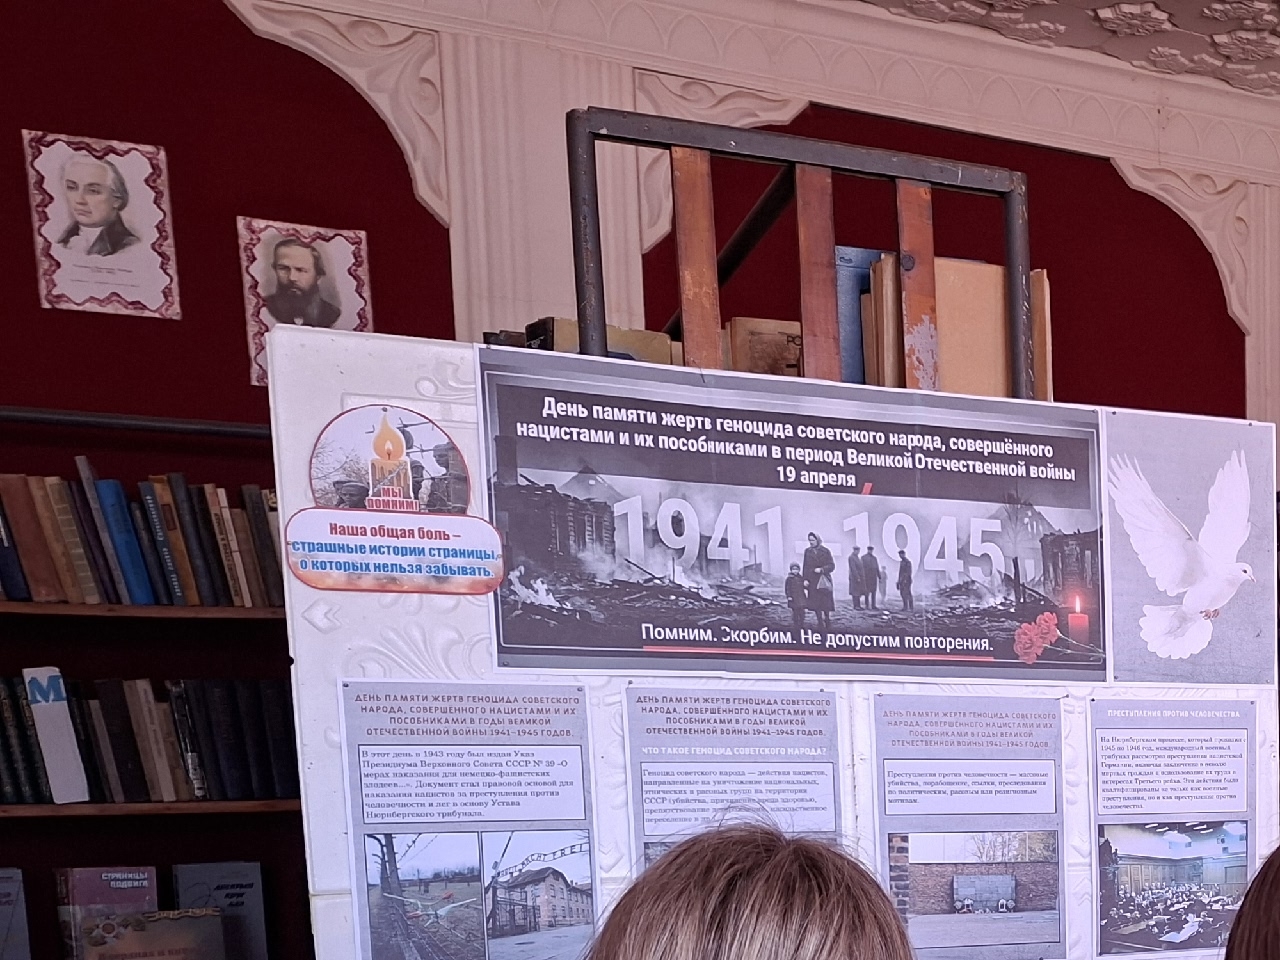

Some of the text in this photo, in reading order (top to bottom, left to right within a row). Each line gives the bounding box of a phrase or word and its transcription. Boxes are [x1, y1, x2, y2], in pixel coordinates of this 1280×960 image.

[542, 396, 1054, 460] День памяти жертв геноцида советского народа, совершённого
[516, 421, 1076, 481] нацистами и их пособниками в период Великой Отечественной войны
[776, 465, 856, 488] 19 апреля
[382, 487, 402, 497] МЫ
[329, 522, 367, 536] Наша
[370, 525, 416, 540] общая
[418, 527, 450, 540] боль
[291, 541, 497, 561] страшные истории страницы,
[300, 559, 494, 577] о которых нельзя забывать.
[641, 623, 718, 643] Помним.
[800, 629, 823, 646] Не
[825, 632, 900, 651] допустим
[905, 635, 994, 653] повторения.
[28, 675, 67, 704] М
[354, 694, 579, 704] ДЕНЬ ПАМЯТИ ЖЕРТВ ГЕНОЦИДА СОВЕТСКОГО
[636, 696, 830, 707] ДЕНЬ ПАМЯТИ ЖЕРТВ ГЕНОЦИДА СОВЕТСКОГО
[360, 705, 406, 714] НАРОДА,
[489, 706, 550, 715] НАЦИСТАМИ
[554, 707, 559, 715] И
[563, 707, 575, 715] ИХ
[389, 717, 550, 725] ПОСОБНИКАМИ В ГОДЫ ВЕЛИКОЙ
[665, 717, 732, 725] ПОСОБНИКАМИ
[768, 718, 805, 726] ВЕЛИКОЙ
[366, 728, 449, 736] ОТЕЧЕСТВЕННОЙ
[452, 728, 486, 736] ВОЙНЫ
[642, 747, 826, 756] ЧТО ТАКОЕ ГЕНОЦИД СОВЕТСКОГО НАРОДА?
